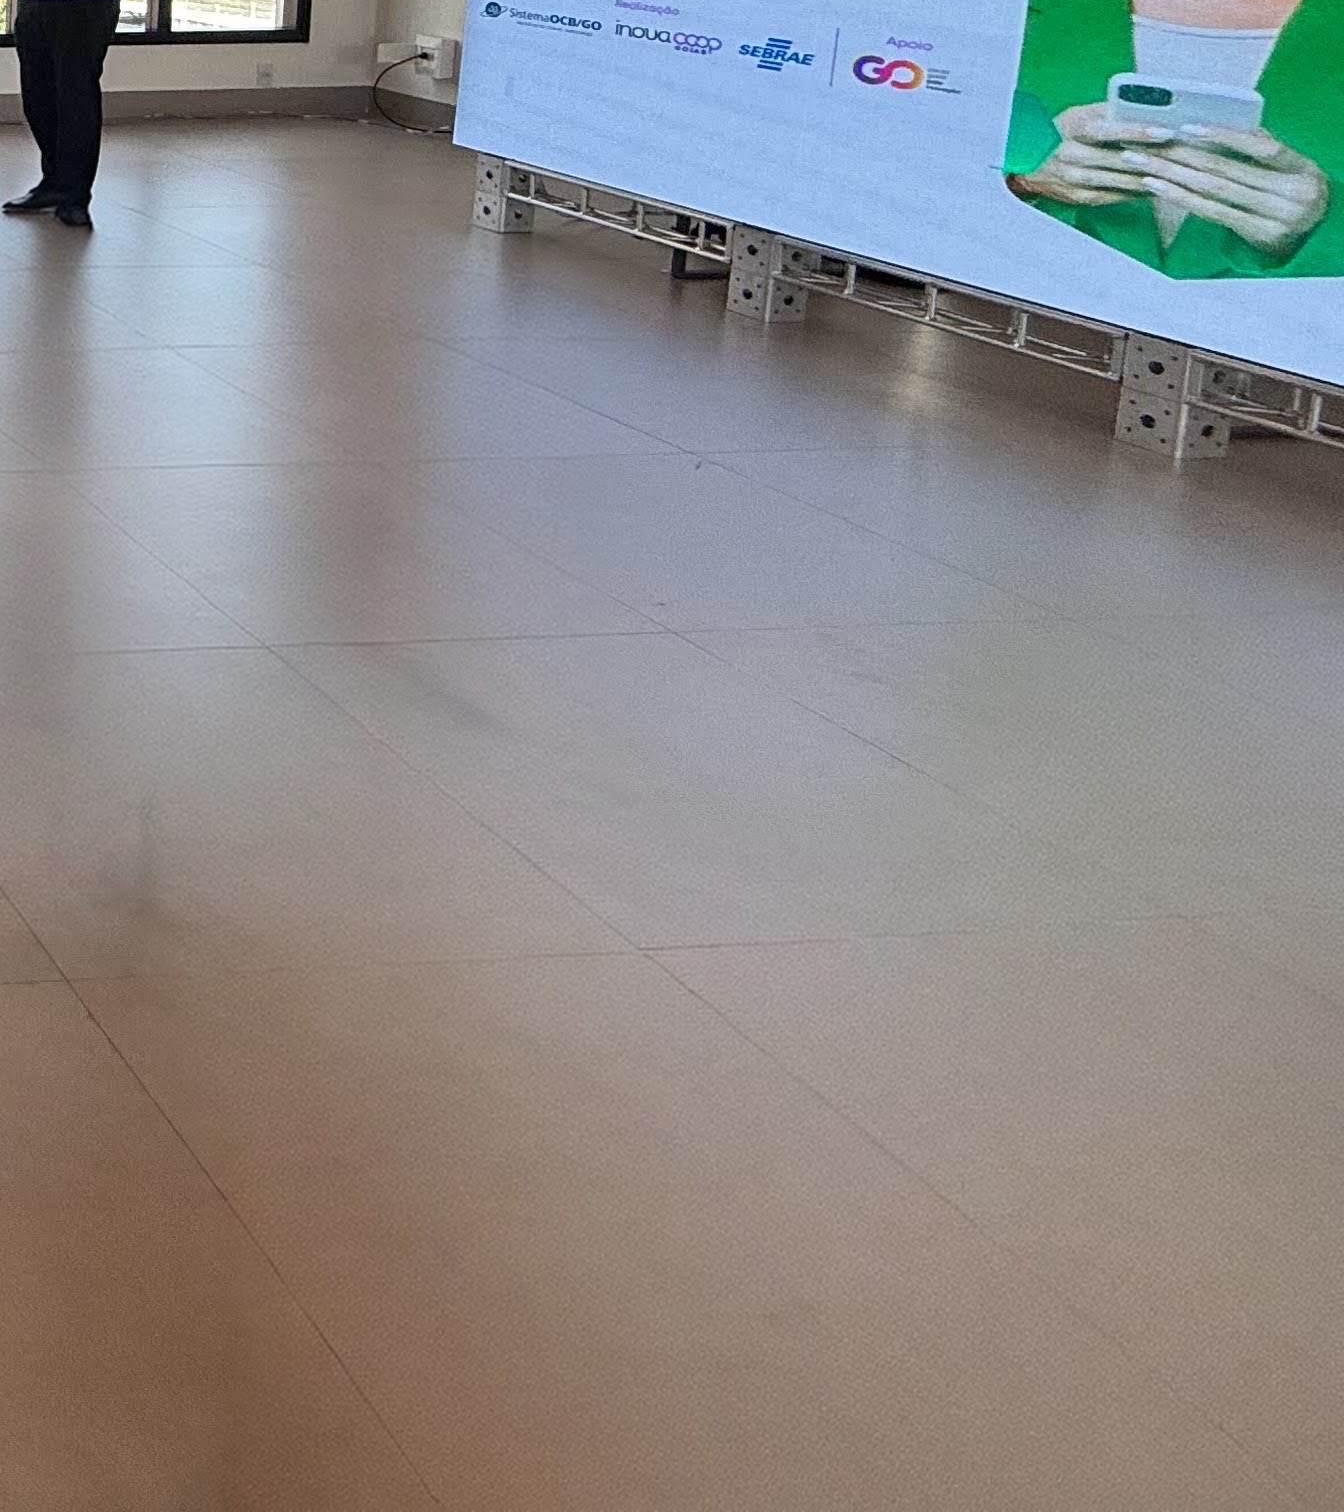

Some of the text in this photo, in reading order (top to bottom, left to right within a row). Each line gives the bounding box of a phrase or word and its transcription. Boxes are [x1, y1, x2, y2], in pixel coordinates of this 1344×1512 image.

[614, 0, 680, 16] Realização
[886, 36, 934, 51] Apoio
[738, 44, 815, 66] SEBRAE
